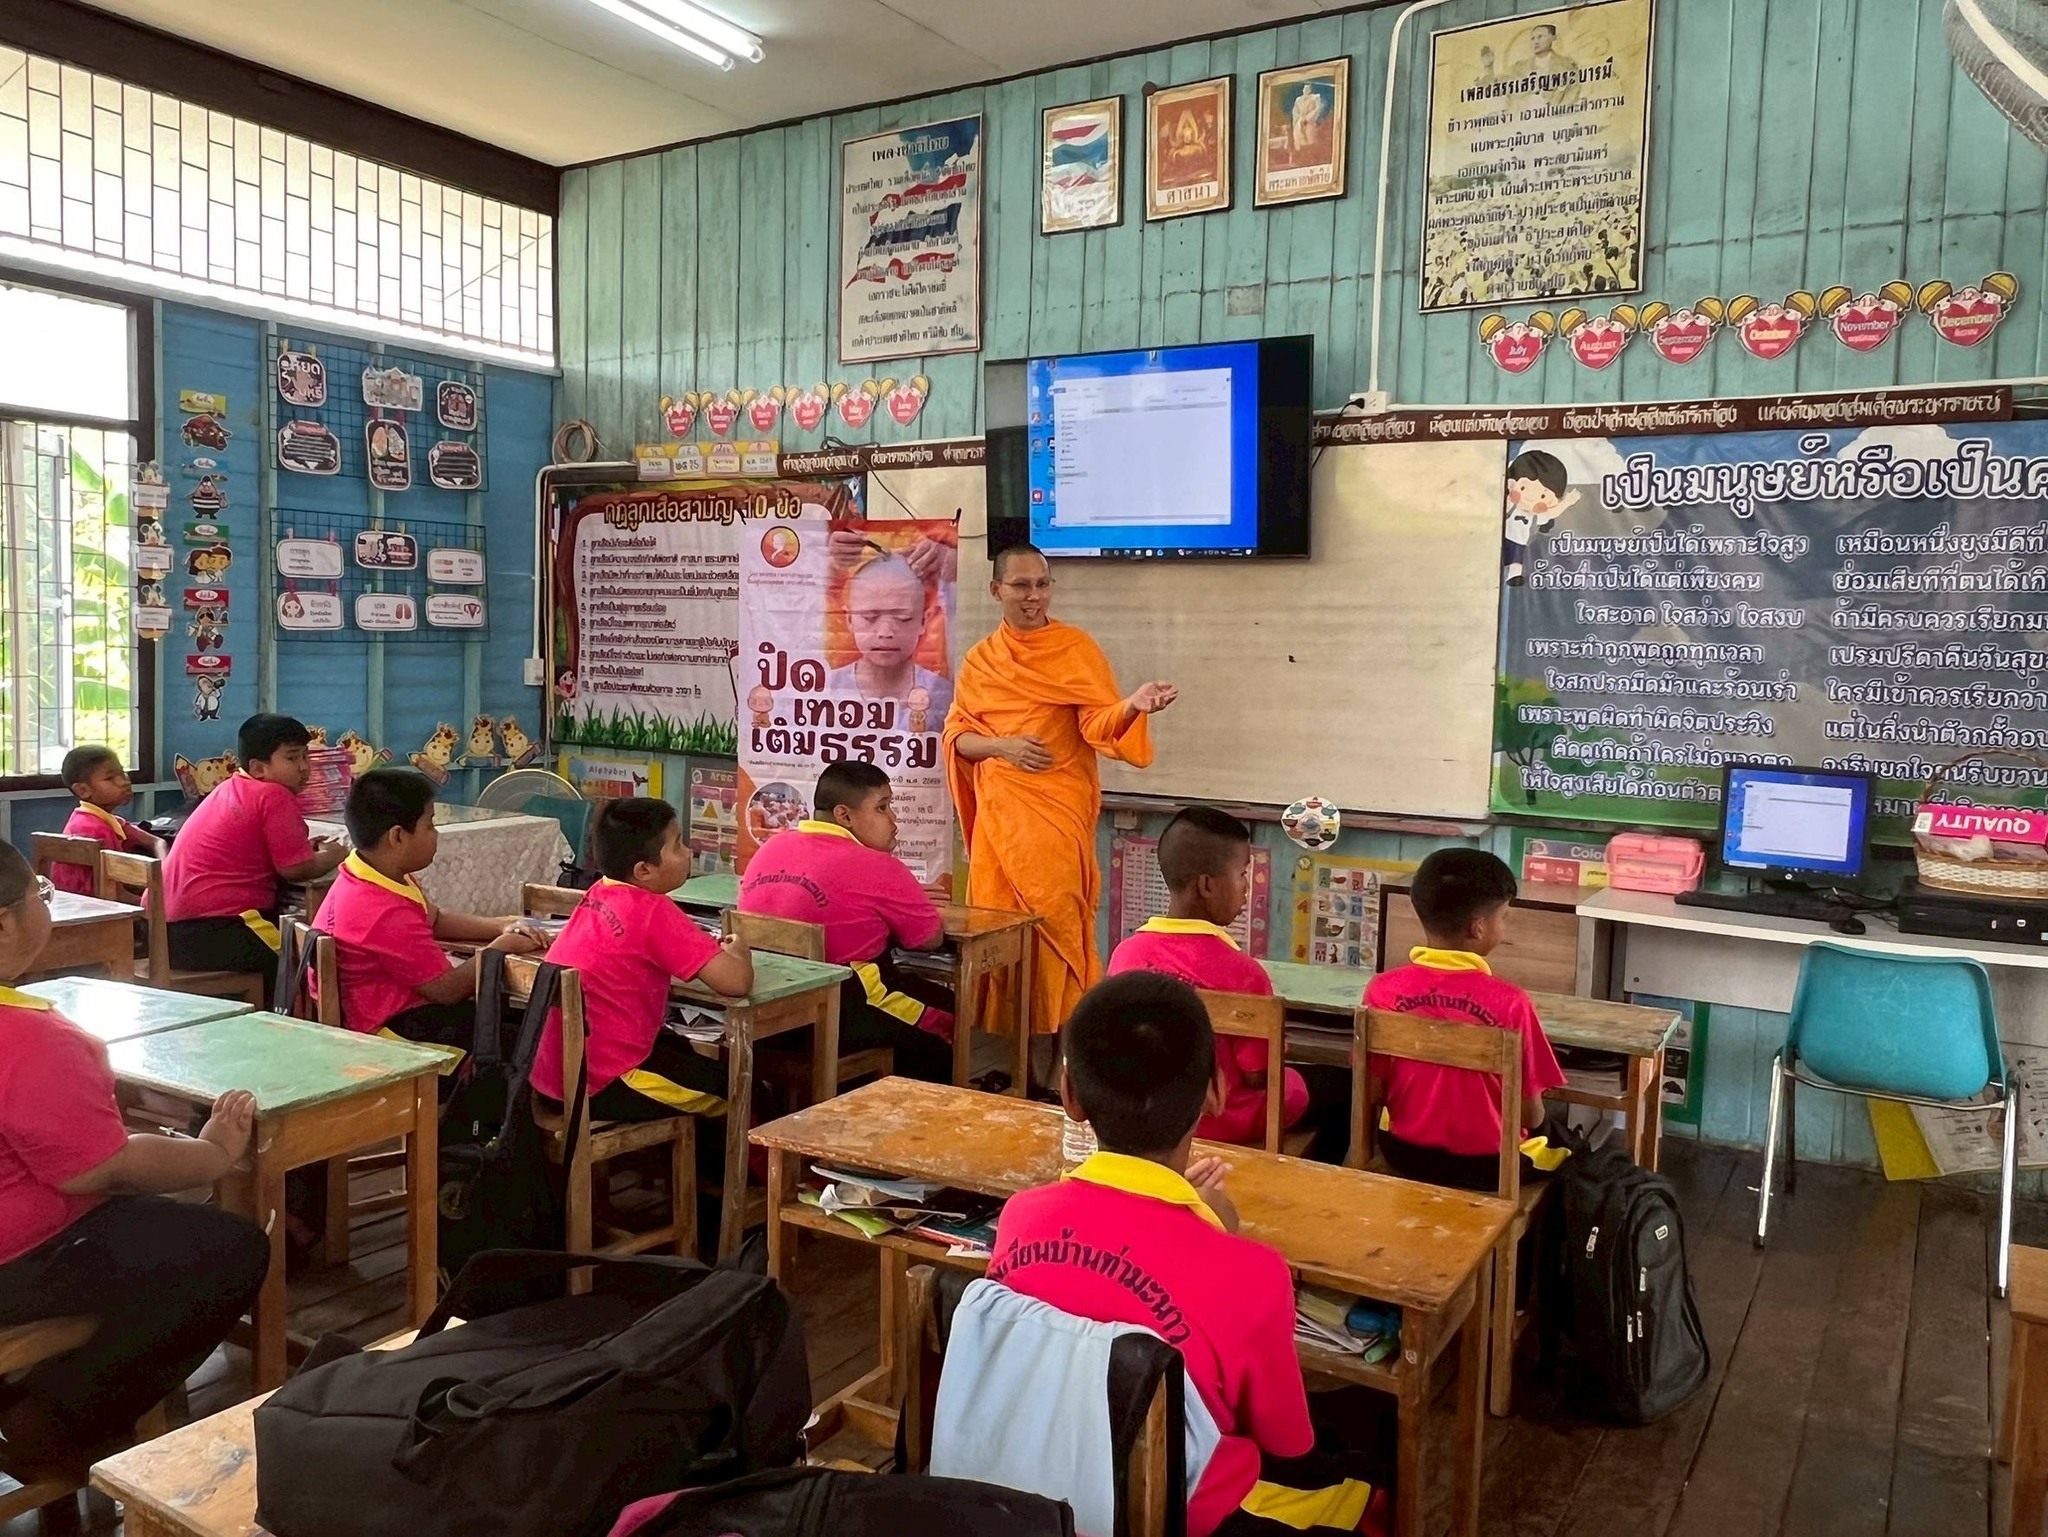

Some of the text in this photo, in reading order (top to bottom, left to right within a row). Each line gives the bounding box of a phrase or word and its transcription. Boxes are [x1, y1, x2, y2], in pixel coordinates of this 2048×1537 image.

[1165, 185, 1212, 205] ศาสนา
[746, 494, 769, 518] 10
[774, 488, 804, 519] ข้อ
[1549, 524, 1809, 562] เป็นมนุษย์เป็นได้เพราะใจสูง
[1529, 561, 1763, 590] ถ้าใจต่ำเป็นได้แต่เพียงคน
[1575, 596, 2048, 631] ใจสะอาด ใจสว่าง ใจสงบ ถ้ามีครบควรเรียกม
[757, 641, 827, 693] ปิด
[1526, 634, 2048, 680] เพราะทำถูกพูดถูกทุกเวลา เปรมปรีดาคืนวันสุข
[1546, 667, 1798, 702] ใจสกปรกมืดมัวและร้อนเร่า
[794, 697, 896, 731] เทอม
[1518, 704, 1774, 737] เพราะพูดผิดทำผิดจิตประวิง
[1934, 813, 2032, 835] QUALITY
[1570, 845, 1608, 860] Colo
